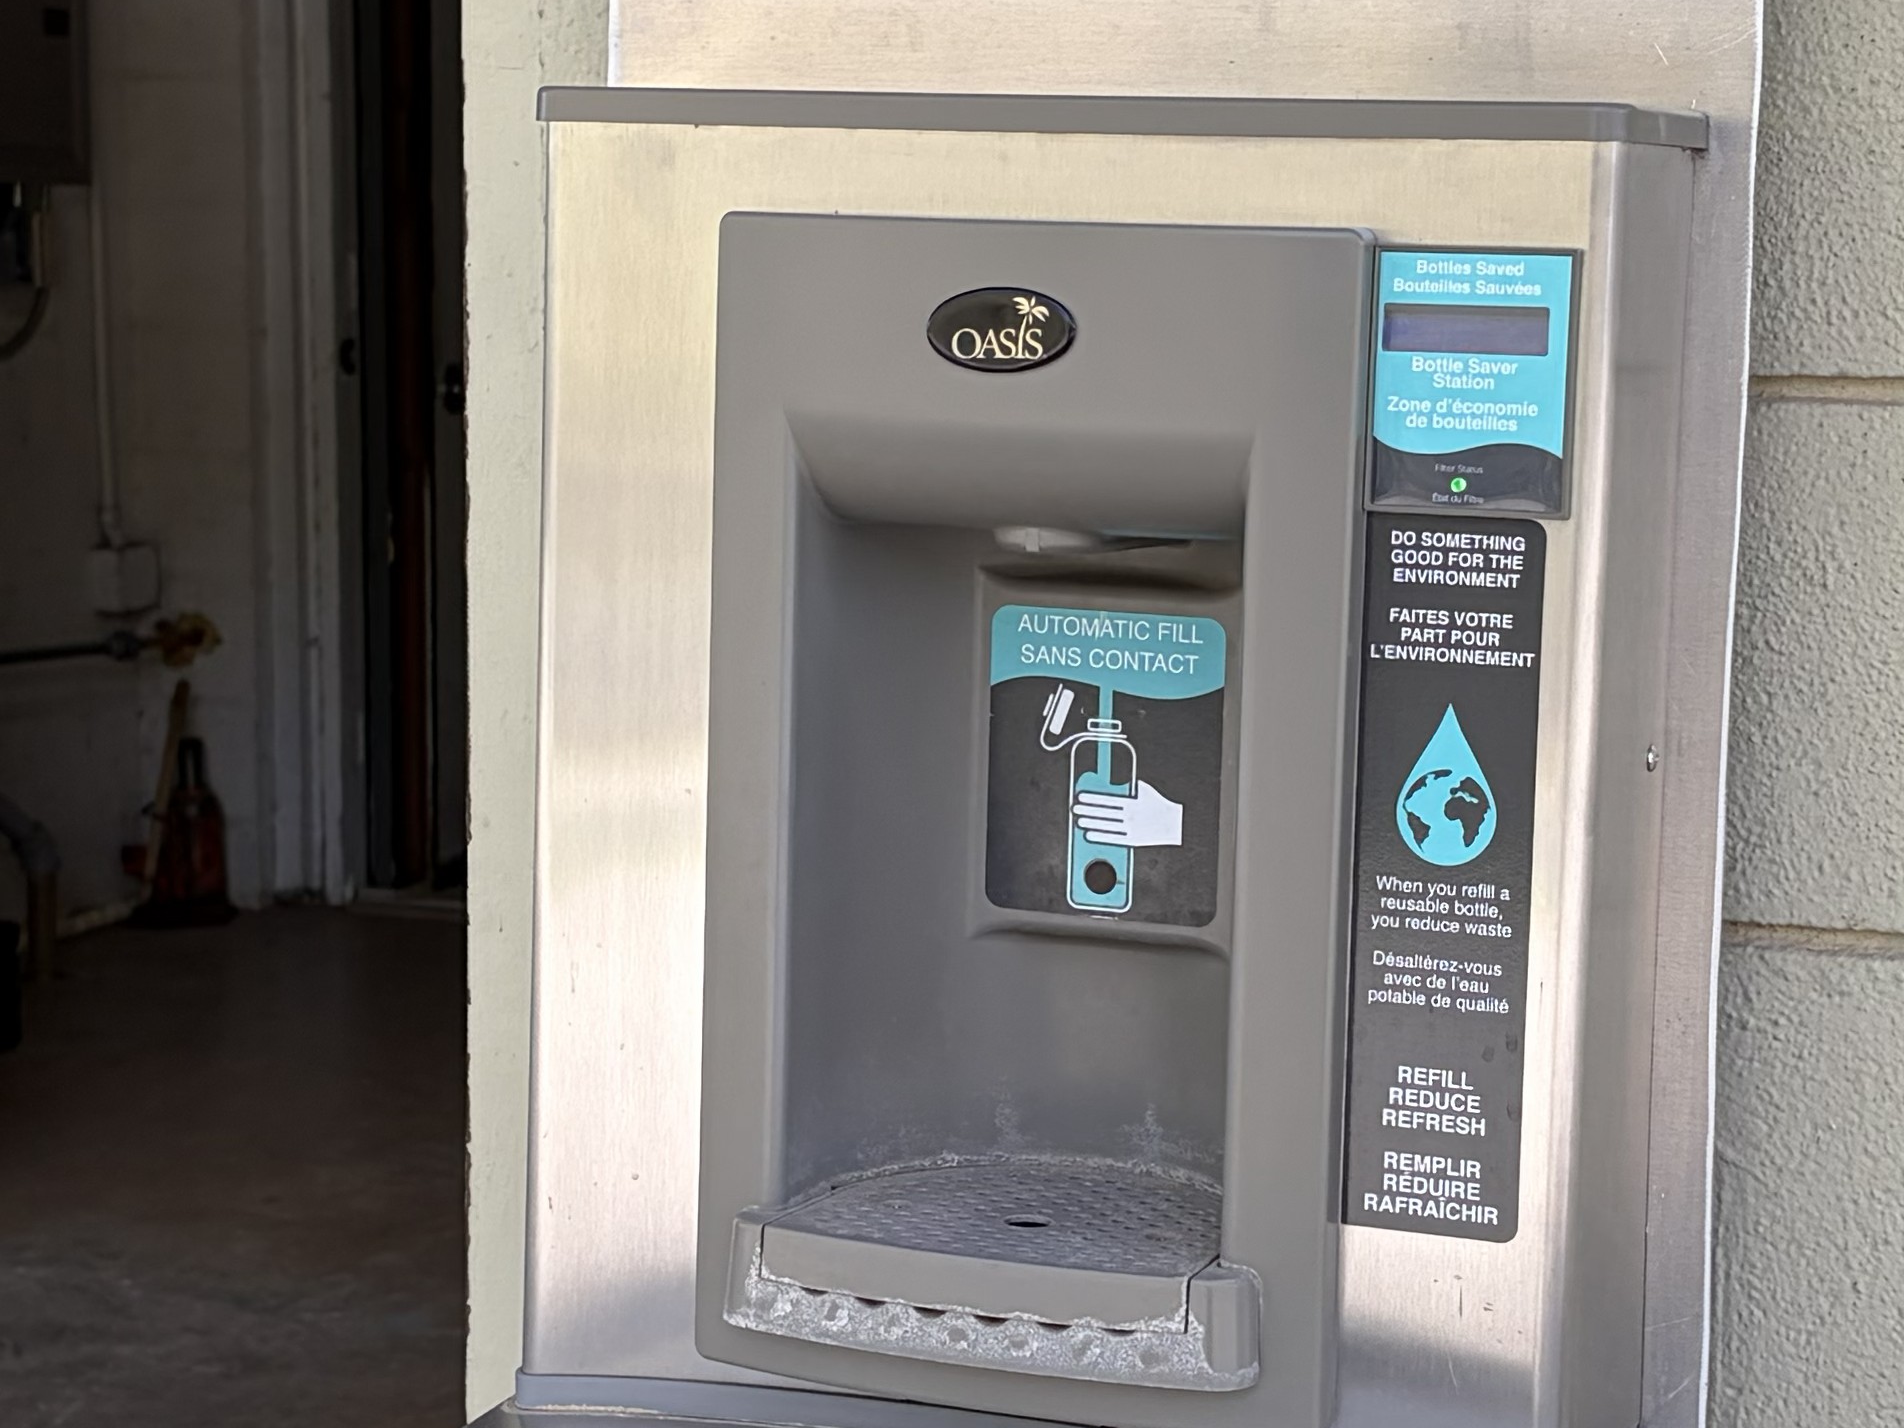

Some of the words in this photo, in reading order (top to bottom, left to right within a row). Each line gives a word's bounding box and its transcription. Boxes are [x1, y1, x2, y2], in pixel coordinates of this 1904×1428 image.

[1417, 260, 1471, 276] Bottles
[1476, 262, 1524, 277] Saved
[1393, 279, 1469, 295] Bouteilles
[1475, 280, 1541, 296] Sauvées
[952, 313, 1044, 361] OASIS
[1412, 356, 1463, 374] Bottle
[1469, 359, 1517, 375] Saver
[1432, 374, 1494, 390] Station
[1388, 397, 1431, 413] Zone
[1436, 398, 1538, 417] d'économie
[1406, 414, 1428, 428] de
[1432, 415, 1517, 431] bouteilles
[1391, 531, 1415, 546] DO
[1421, 532, 1525, 552] SOMETHING
[1391, 550, 1443, 566] GOOD
[1448, 552, 1483, 568] FOR
[1489, 553, 1523, 570] THE
[1393, 569, 1520, 589] ENVIRONMENT
[1018, 614, 1149, 640] AUTOMATIC
[1158, 623, 1203, 644] FILL
[1389, 608, 1450, 625] FAITES
[1454, 611, 1513, 629] VOTRE
[1401, 627, 1445, 644] PART
[1451, 630, 1499, 647] POUR
[1021, 644, 1081, 668] SANS
[1089, 649, 1199, 674] CONTACT
[1370, 645, 1535, 667] L'ENVIRONNEMENT
[1376, 876, 1422, 894] When
[1426, 883, 1457, 900] you
[1461, 883, 1495, 900] refill
[1500, 888, 1510, 901] a
[1380, 896, 1449, 914] reusable
[1455, 900, 1503, 919] bottle,
[1371, 914, 1399, 931] you
[1405, 916, 1459, 934] reduce
[1464, 923, 1512, 939] waste
[1384, 973, 1421, 988] avec
[1426, 975, 1446, 989] de
[1451, 976, 1489, 994] l'eau
[1368, 989, 1426, 1008] potable
[1431, 993, 1451, 1008] de
[1455, 995, 1509, 1015] qualité
[1398, 1067, 1473, 1091] REFILL
[1389, 1089, 1481, 1113] REDUCE
[1382, 1109, 1485, 1137] REFRESH
[1384, 1152, 1481, 1179] REMPLIR
[1383, 1172, 1481, 1200] RÉDUIRE
[1364, 1193, 1499, 1225] RAFRAÎCHIR
